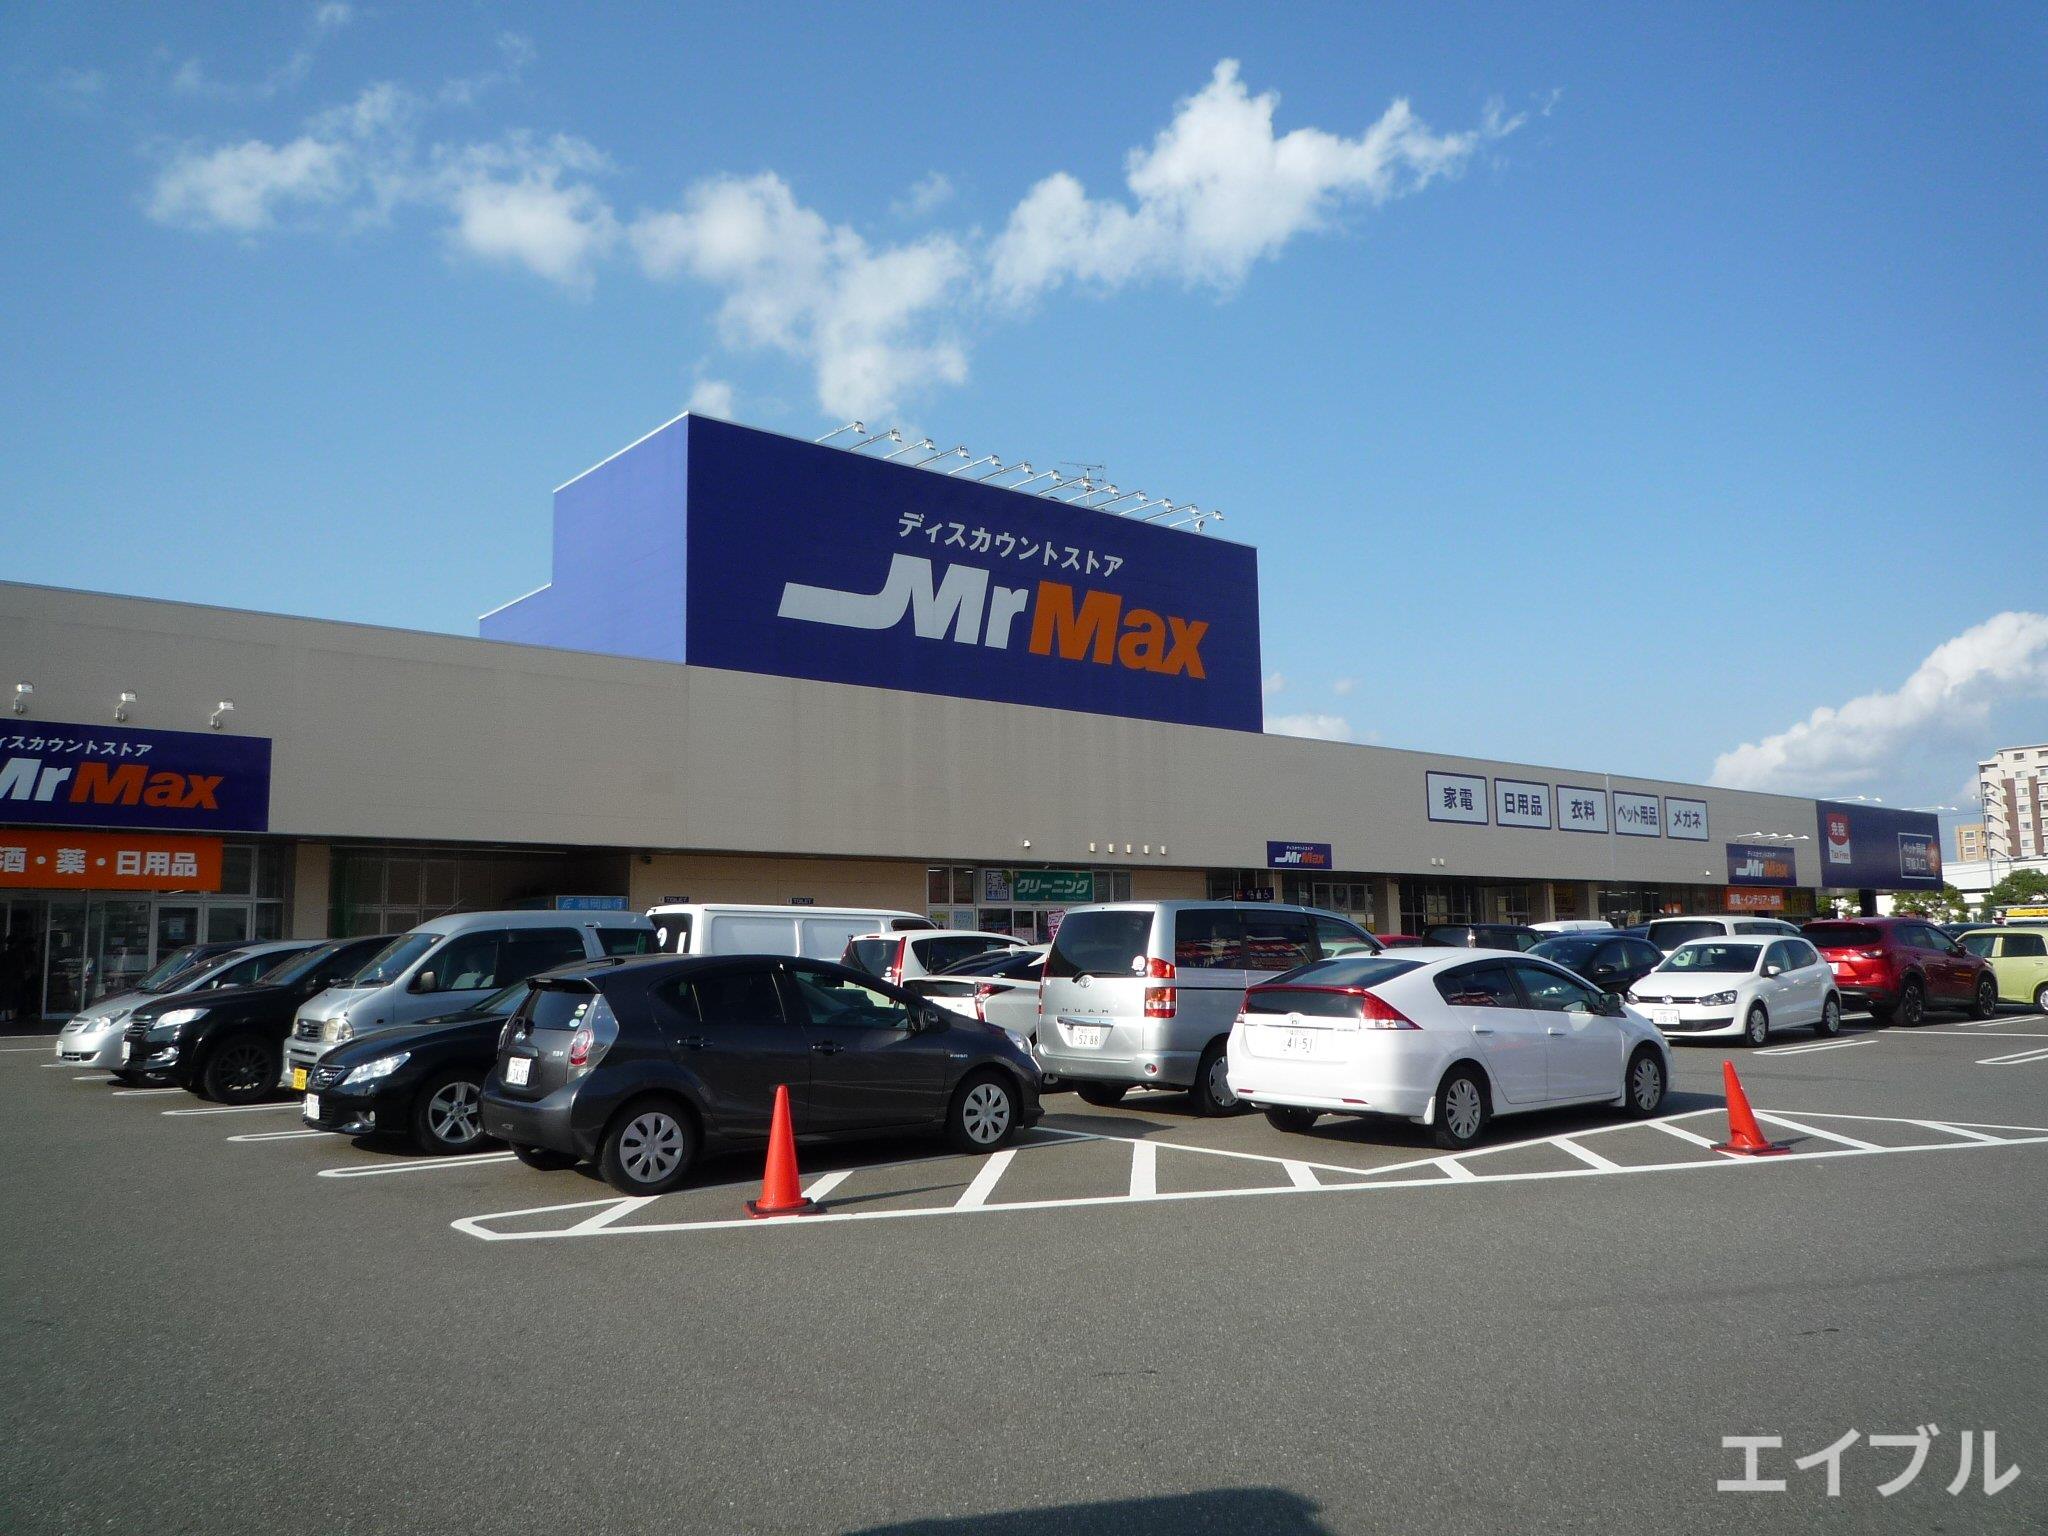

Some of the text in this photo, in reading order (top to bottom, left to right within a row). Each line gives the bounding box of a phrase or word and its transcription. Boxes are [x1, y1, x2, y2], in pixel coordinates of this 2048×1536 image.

[898, 511, 1124, 577] ディスカウントストア
[1443, 786, 1473, 811] 家電
[1504, 792, 1542, 817] 日用品
[1571, 799, 1596, 821] 衣料
[1618, 805, 1658, 826] ペット用品
[1673, 810, 1702, 829] メガネ
[1017, 879, 1089, 894] クリーニング
